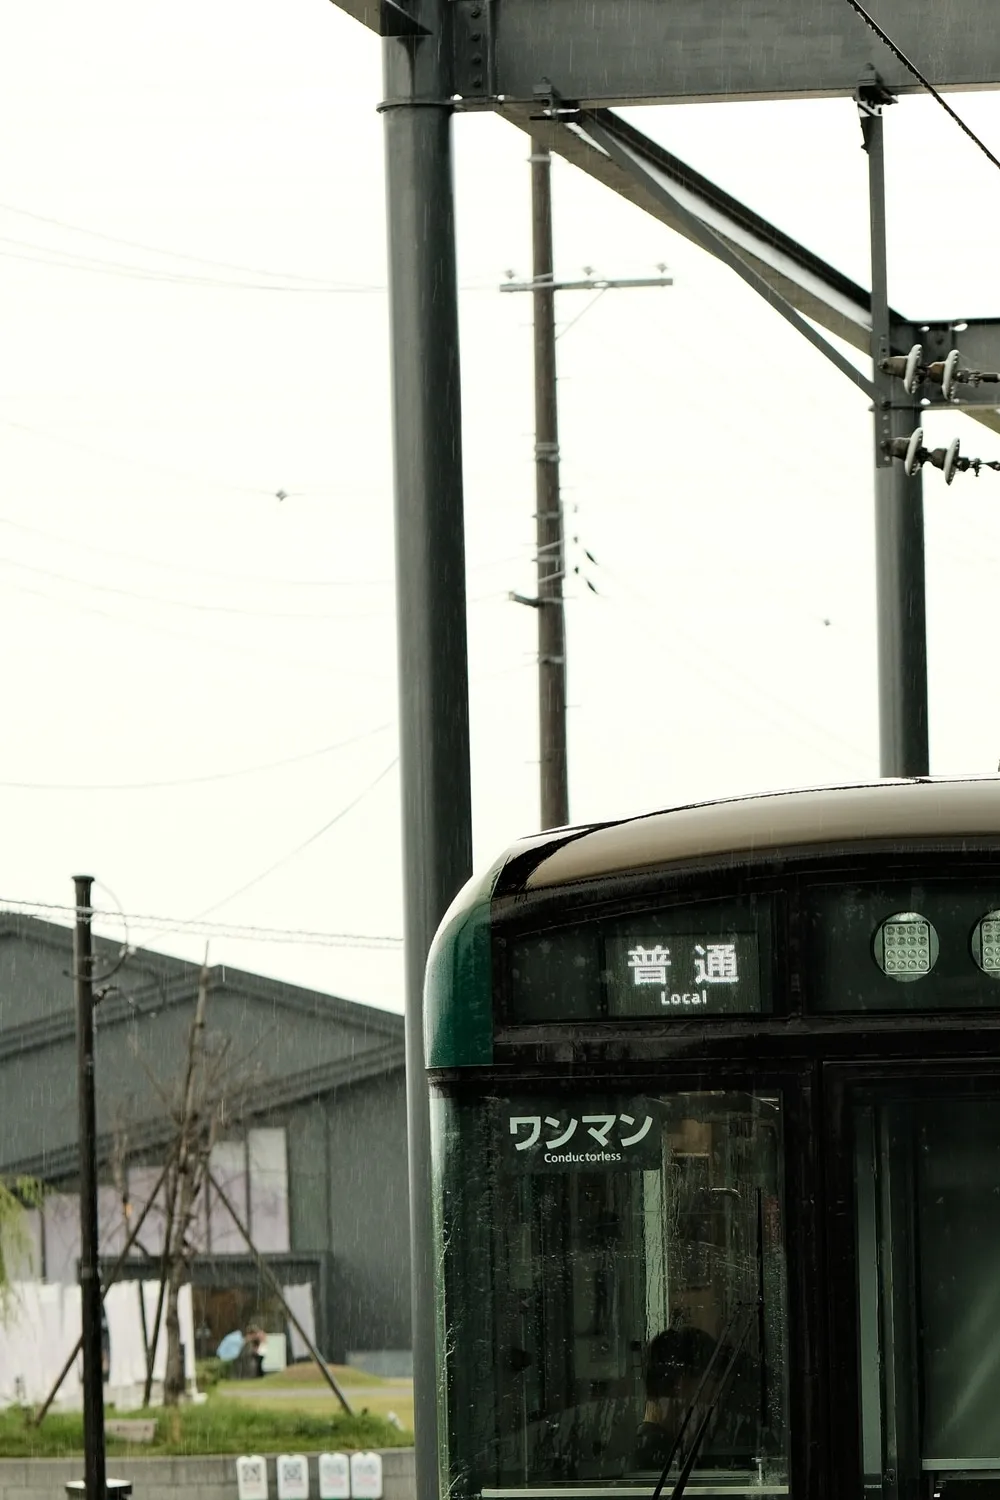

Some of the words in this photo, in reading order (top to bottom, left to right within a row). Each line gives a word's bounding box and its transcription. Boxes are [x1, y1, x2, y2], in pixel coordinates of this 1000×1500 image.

[627, 944, 740, 985] 普通
[660, 990, 707, 1005] Local
[509, 1114, 654, 1151] ワンマン
[543, 1152, 622, 1164] Conductorless
